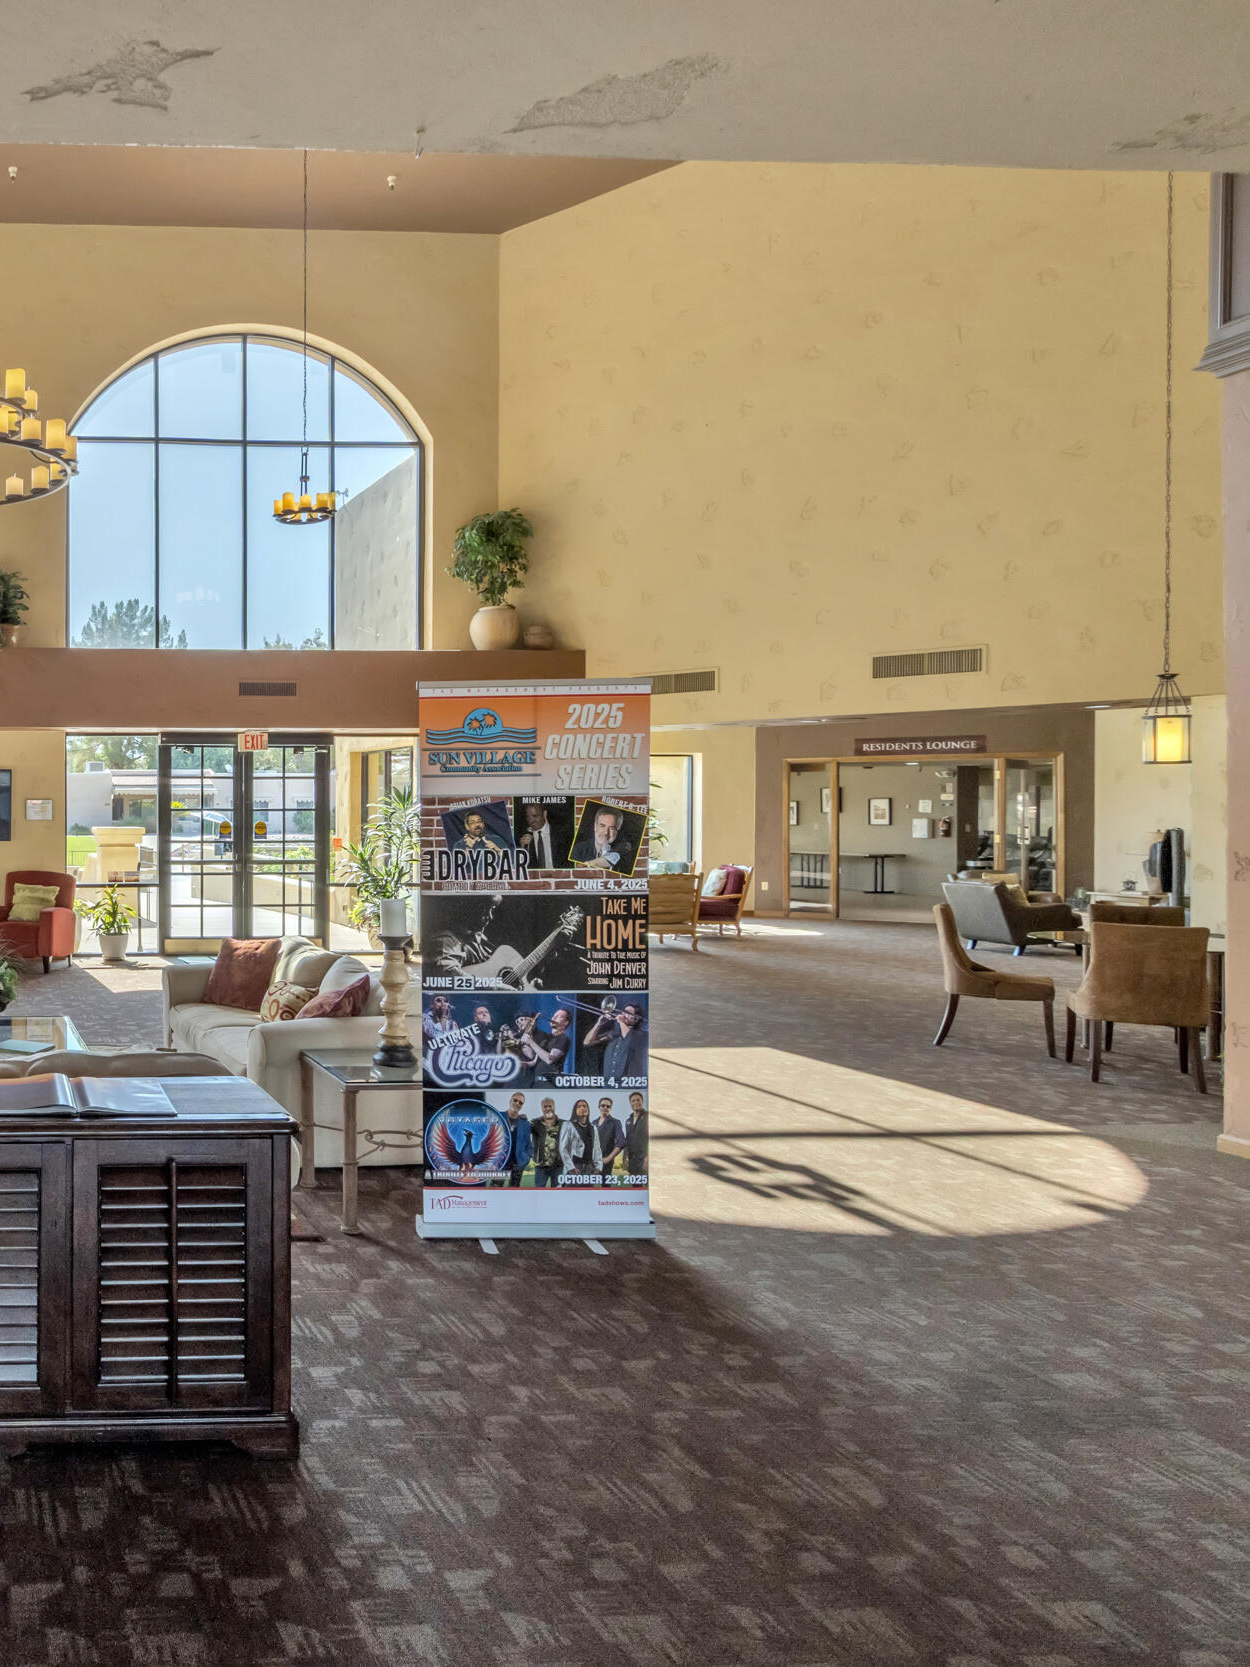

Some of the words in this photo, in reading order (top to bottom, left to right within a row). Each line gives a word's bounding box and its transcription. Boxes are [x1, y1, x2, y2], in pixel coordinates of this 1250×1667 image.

[564, 703, 625, 730] 2025
[244, 734, 264, 750] EXIT
[544, 733, 646, 760] CONCERT
[862, 742, 923, 752] RESIDENTS
[926, 740, 977, 750] LOUNGE
[429, 751, 461, 765] SUN
[463, 751, 537, 765] VILLAGE
[440, 765, 482, 774] Community
[483, 764, 523, 773] Association
[555, 764, 634, 790] SERIES
[522, 796, 541, 804] MIKE
[542, 796, 567, 804] JAMES
[438, 849, 529, 881] DRYBAR
[574, 880, 605, 890] JUNE
[607, 880, 619, 891] 4,
[621, 880, 648, 890] 2025
[601, 897, 628, 915] TAKE
[586, 915, 647, 950] HOME
[587, 961, 611, 975] JOHN
[613, 961, 647, 975] DENVER
[423, 976, 454, 988] JUNE
[456, 978, 473, 988] 25
[475, 976, 503, 988] 2025
[610, 977, 623, 989] JIM
[624, 977, 647, 989] CURRY
[428, 1023, 481, 1051] ULTIMATE
[431, 1036, 517, 1084] Chicago
[555, 1076, 605, 1087] OCTOBER
[607, 1076, 619, 1089] 4,
[621, 1076, 648, 1087] 2025
[557, 1174, 603, 1185] OCTOBER
[605, 1174, 621, 1186] 23,
[623, 1174, 648, 1185] 2025
